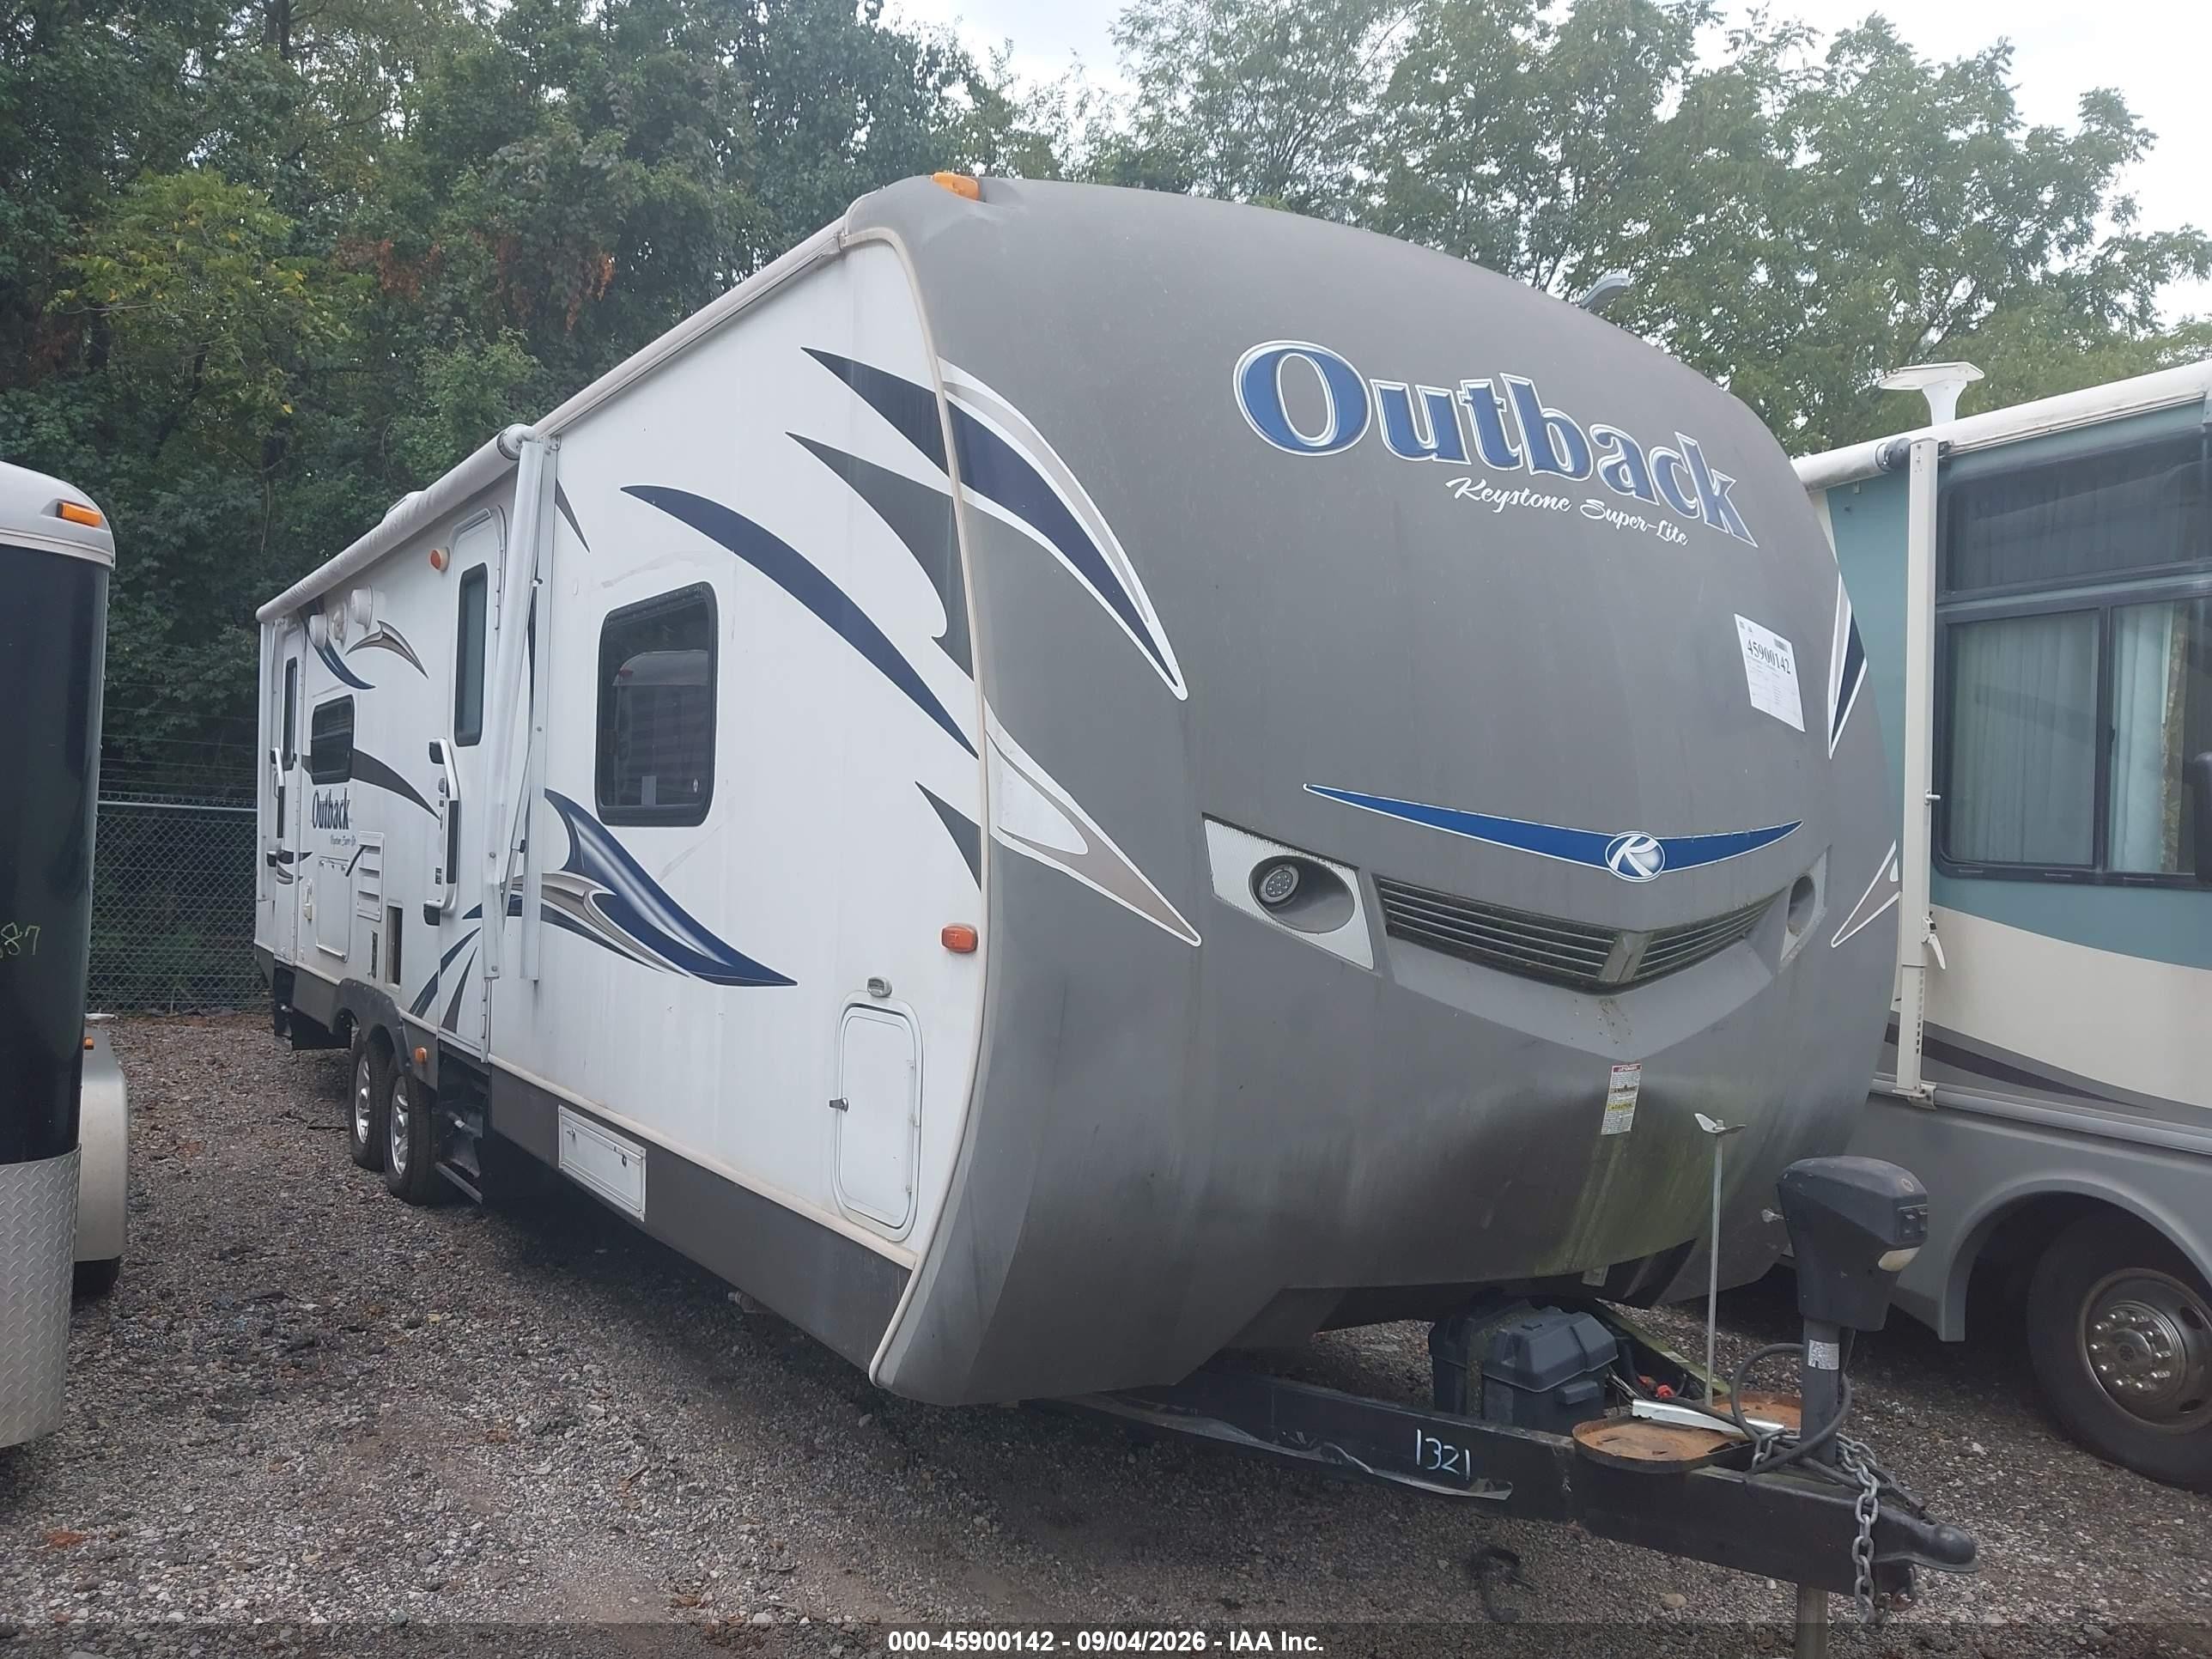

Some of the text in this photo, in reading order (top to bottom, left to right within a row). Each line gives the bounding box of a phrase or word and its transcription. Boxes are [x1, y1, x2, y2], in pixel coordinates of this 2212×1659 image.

[1233, 340, 1759, 547] Outback
[1444, 477, 1690, 546] Keystone Super-Lite
[1747, 638, 1791, 675] 45900142
[312, 787, 351, 830] Outback
[0, 921, 41, 959] 87
[1415, 1428, 1472, 1481] 1321
